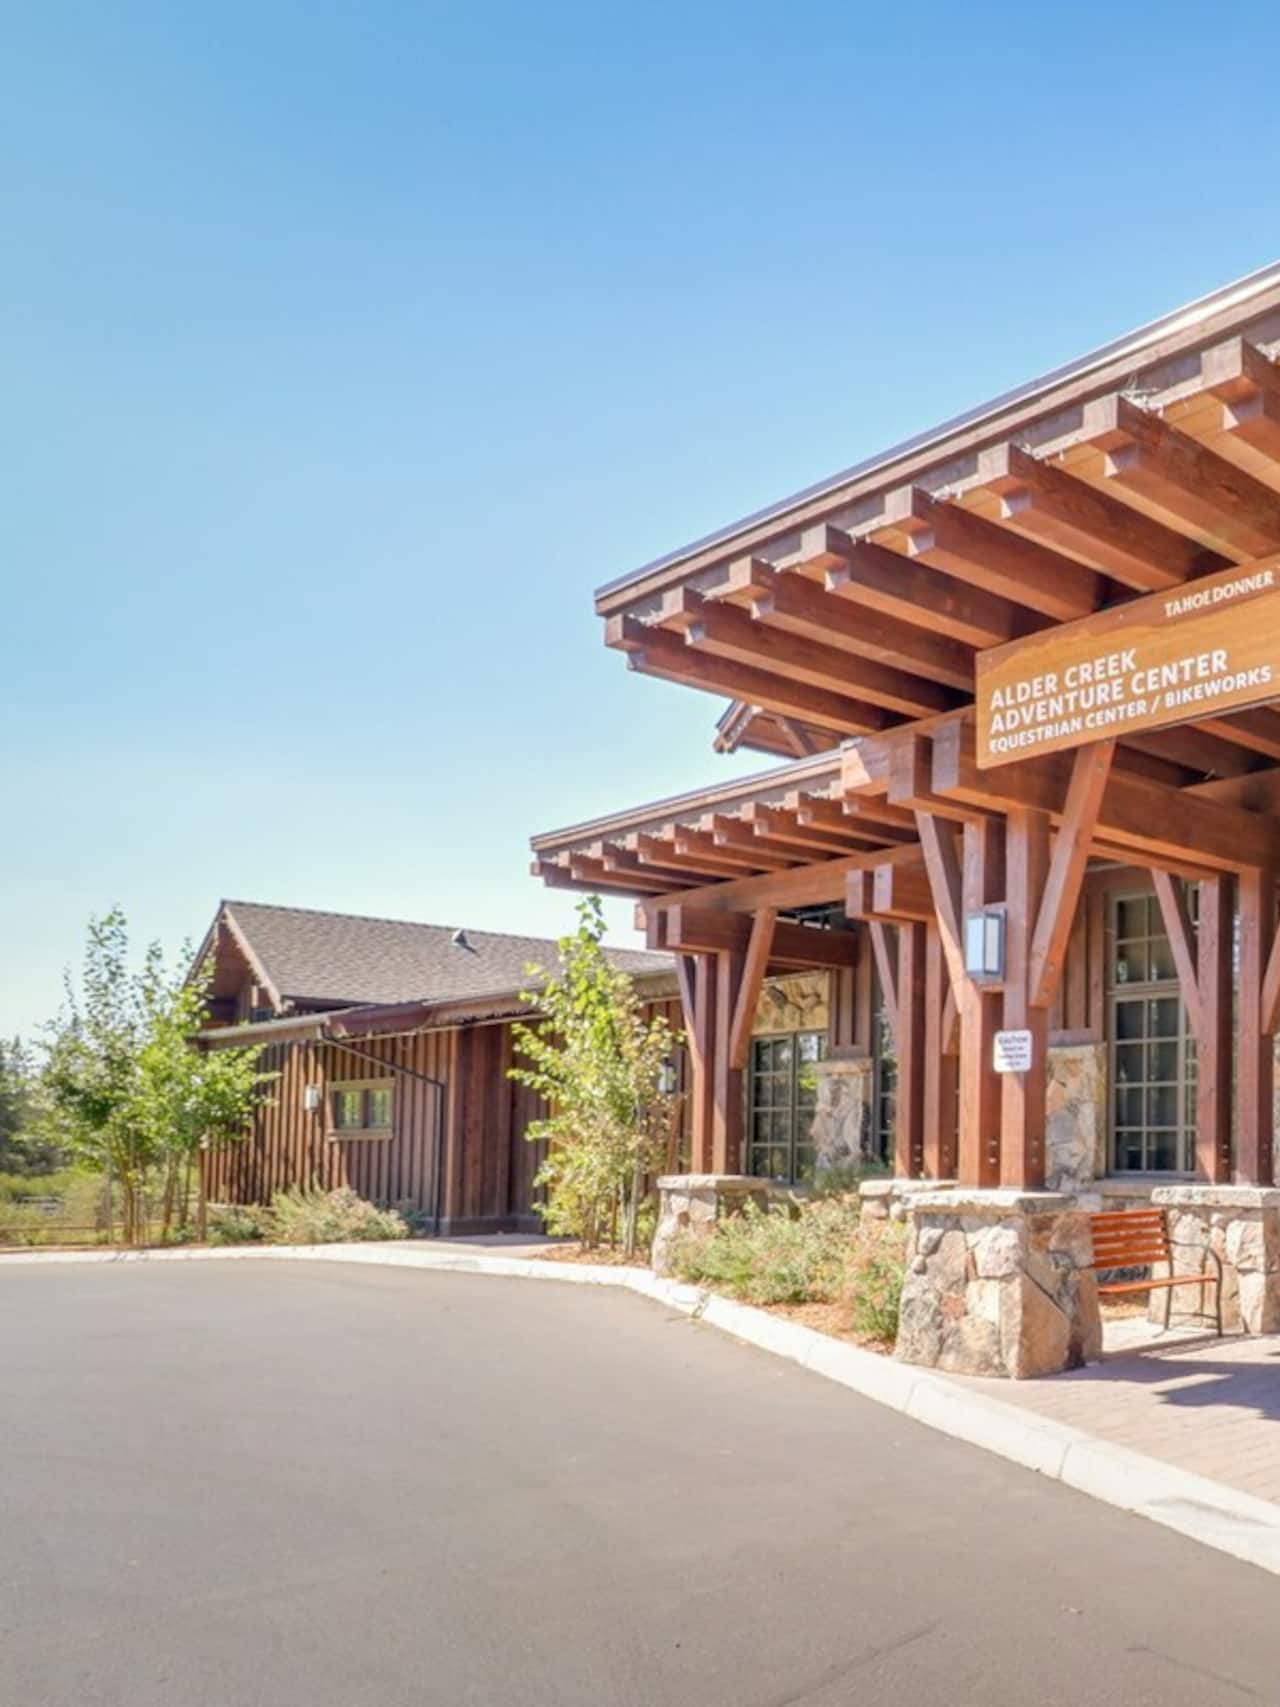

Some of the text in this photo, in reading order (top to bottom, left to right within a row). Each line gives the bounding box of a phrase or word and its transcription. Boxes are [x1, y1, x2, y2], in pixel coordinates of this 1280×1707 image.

[1164, 570, 1274, 618] TAHOE DONNER
[989, 648, 1137, 711] ALDER CREEK
[989, 649, 1228, 735] ADVENTURE CENTER
[989, 717, 1082, 753] EQUESTRIAN
[1085, 699, 1147, 729] CENTER
[1164, 665, 1272, 708] BIKEWORKS
